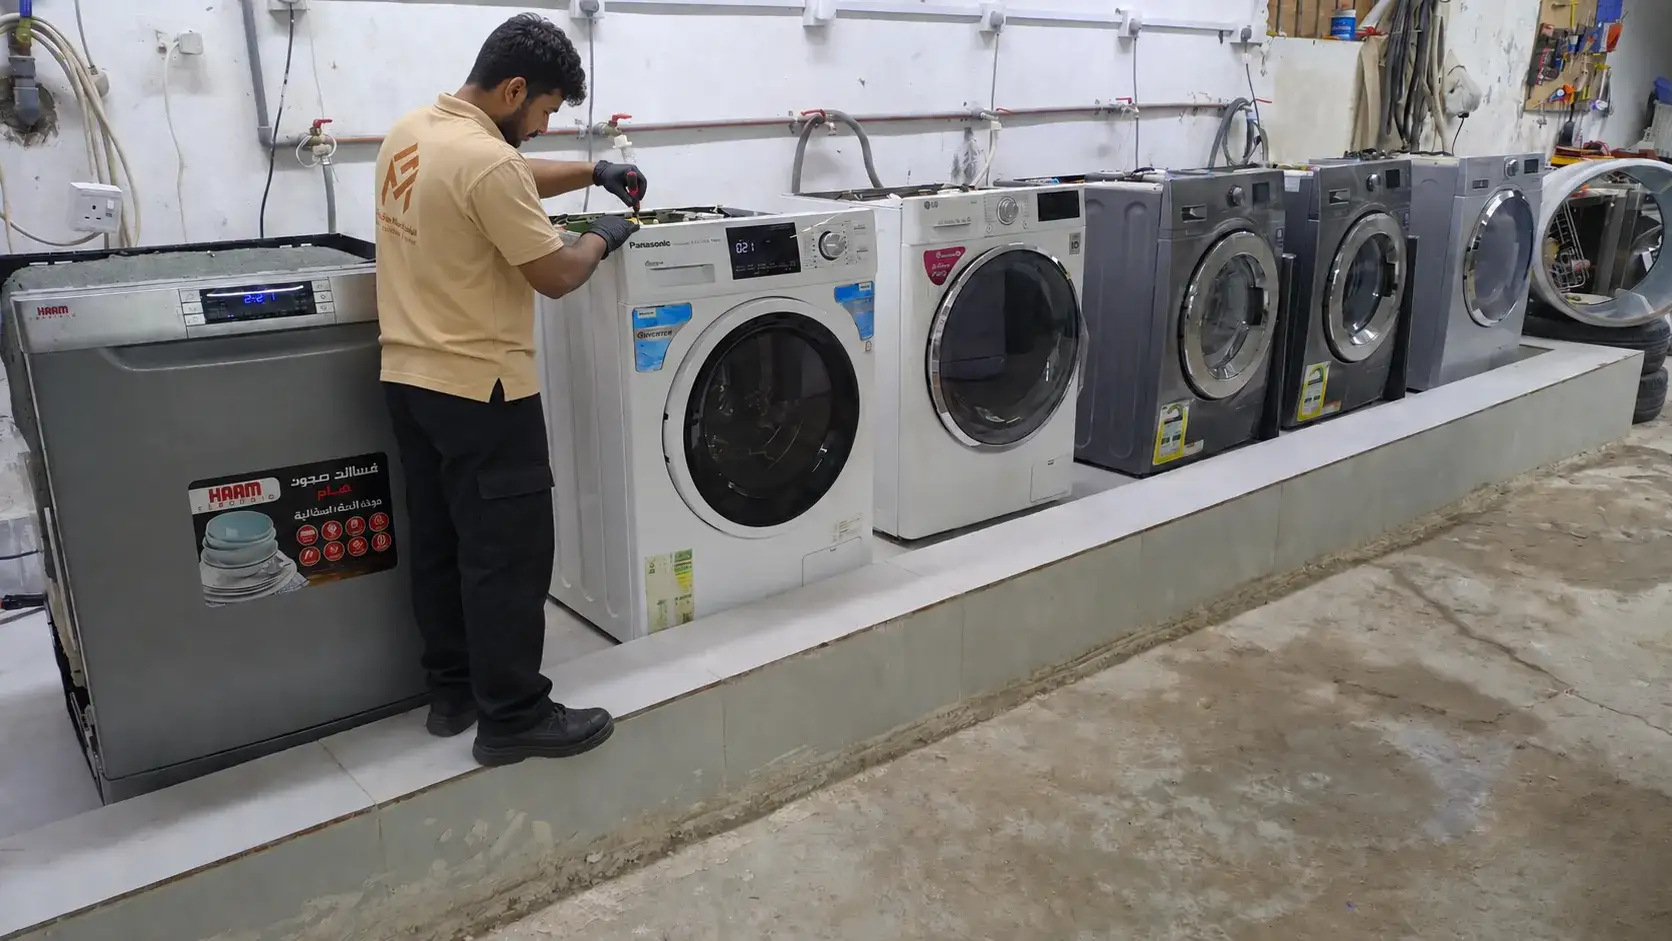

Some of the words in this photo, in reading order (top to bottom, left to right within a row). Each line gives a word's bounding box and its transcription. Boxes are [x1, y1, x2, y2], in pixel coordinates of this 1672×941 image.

[628, 239, 671, 250] Panasonic
[735, 242, 755, 254] 021
[208, 481, 262, 504] HAAM
